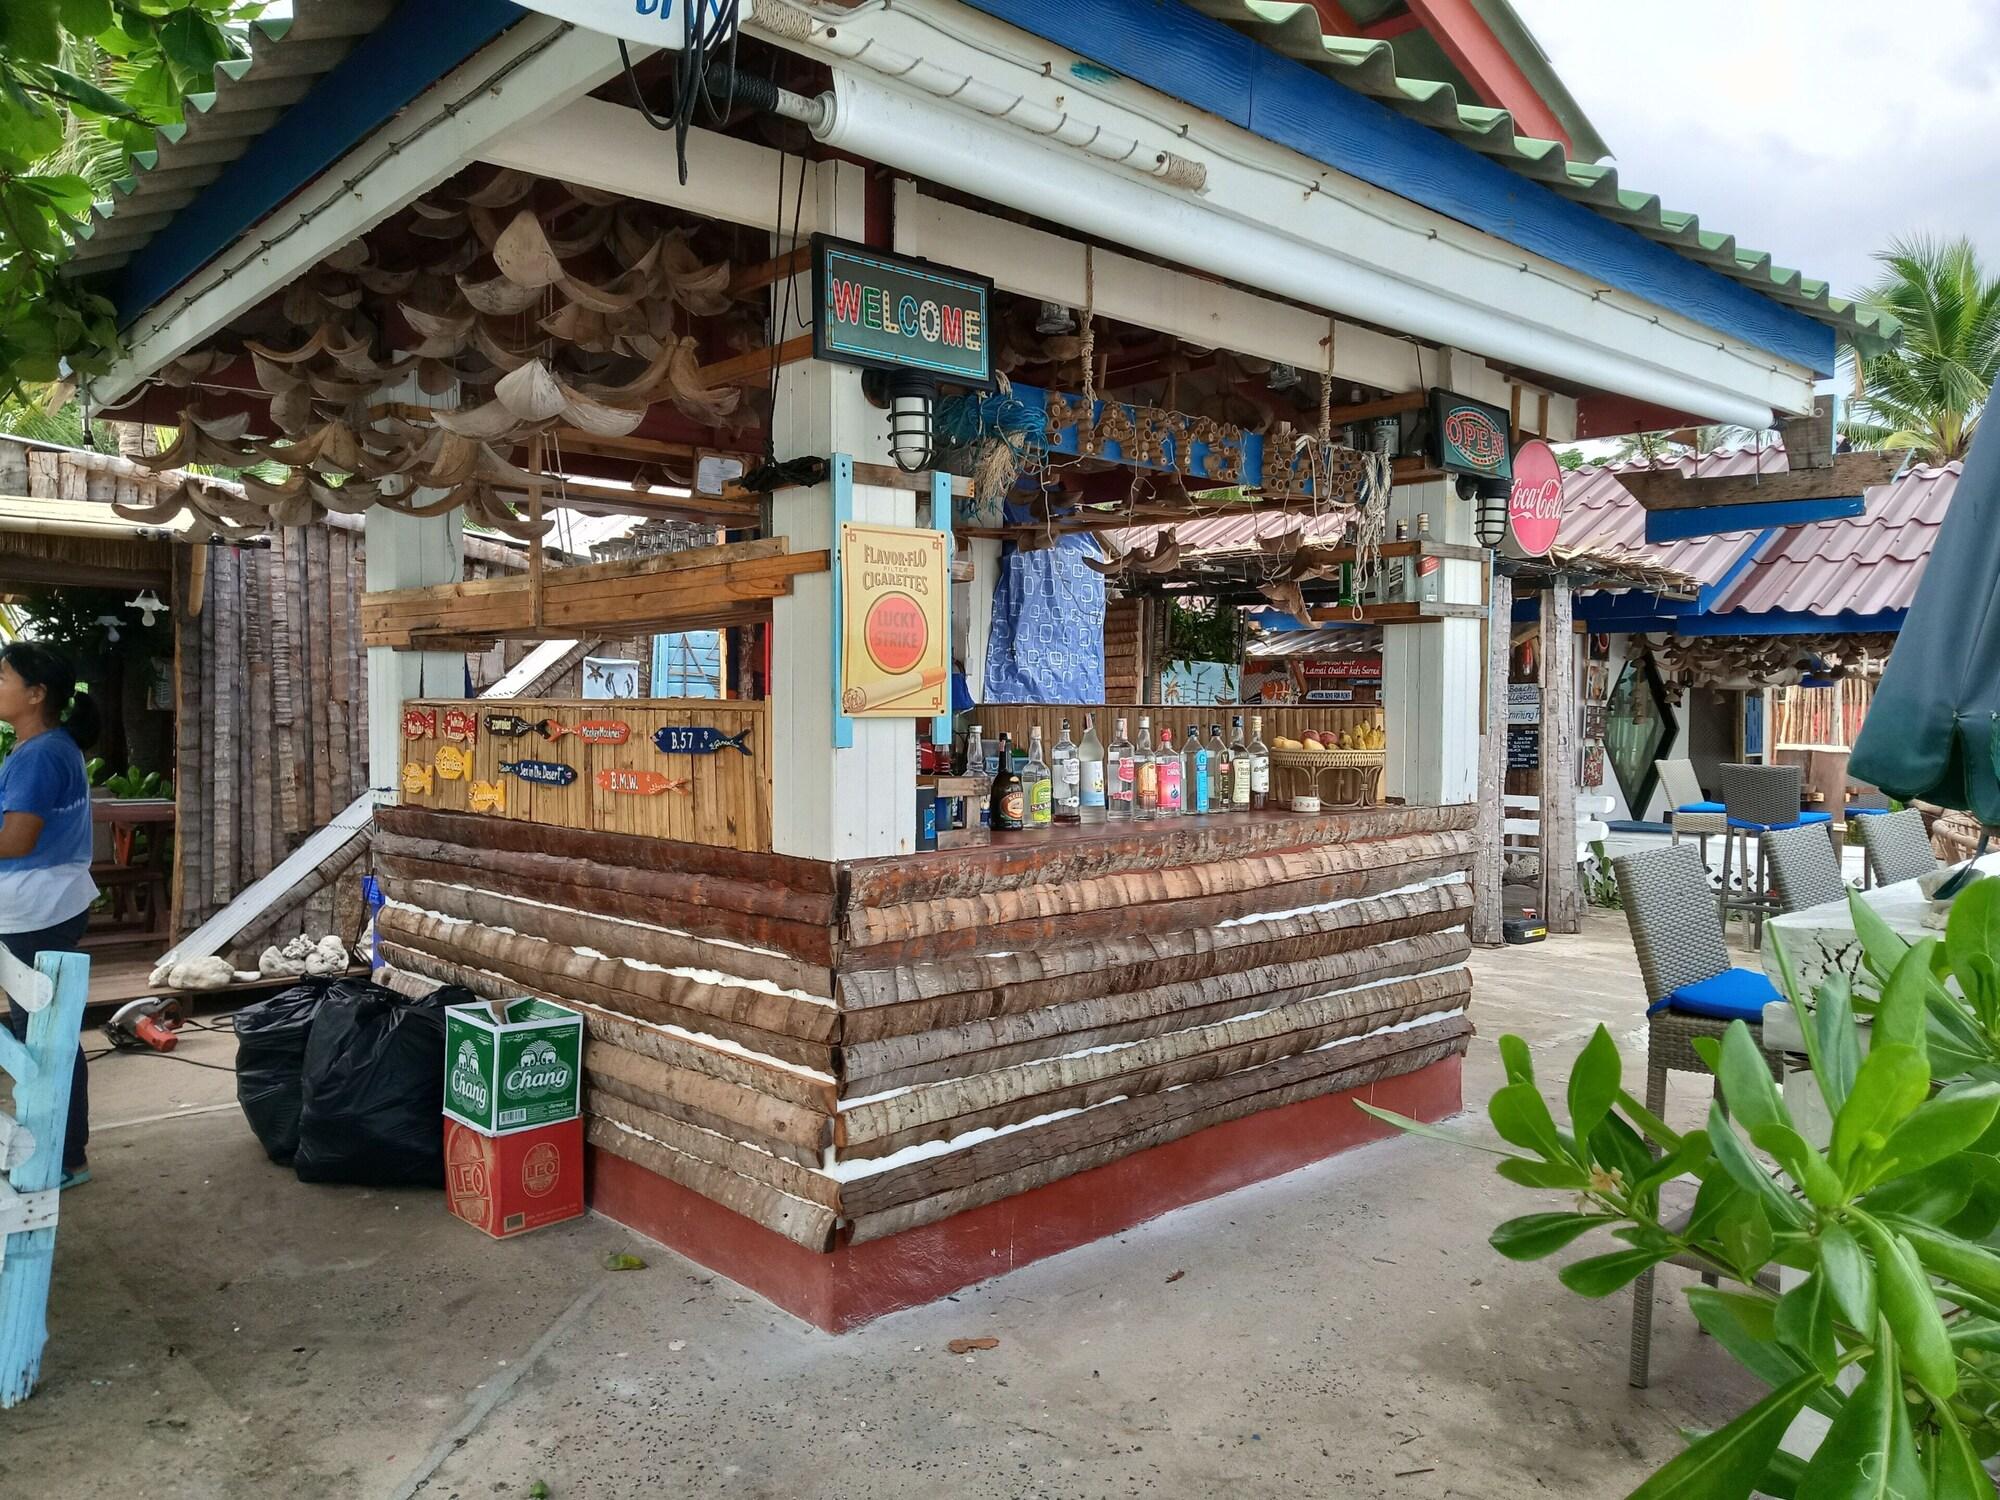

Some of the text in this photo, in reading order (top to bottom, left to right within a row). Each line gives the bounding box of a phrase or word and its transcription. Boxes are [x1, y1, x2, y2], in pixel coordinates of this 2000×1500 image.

[832, 278, 981, 352] WELCOME
[1445, 415, 1505, 459] OPEN
[862, 571, 929, 596] CIGARETTES
[877, 610, 916, 628] LUCKY
[874, 630, 919, 649] STRIKE
[671, 732, 694, 750] B.57
[452, 1070, 486, 1109] Chang
[506, 1069, 568, 1091] Chang
[451, 1162, 486, 1198] LEO
[525, 1161, 556, 1181] LEO
